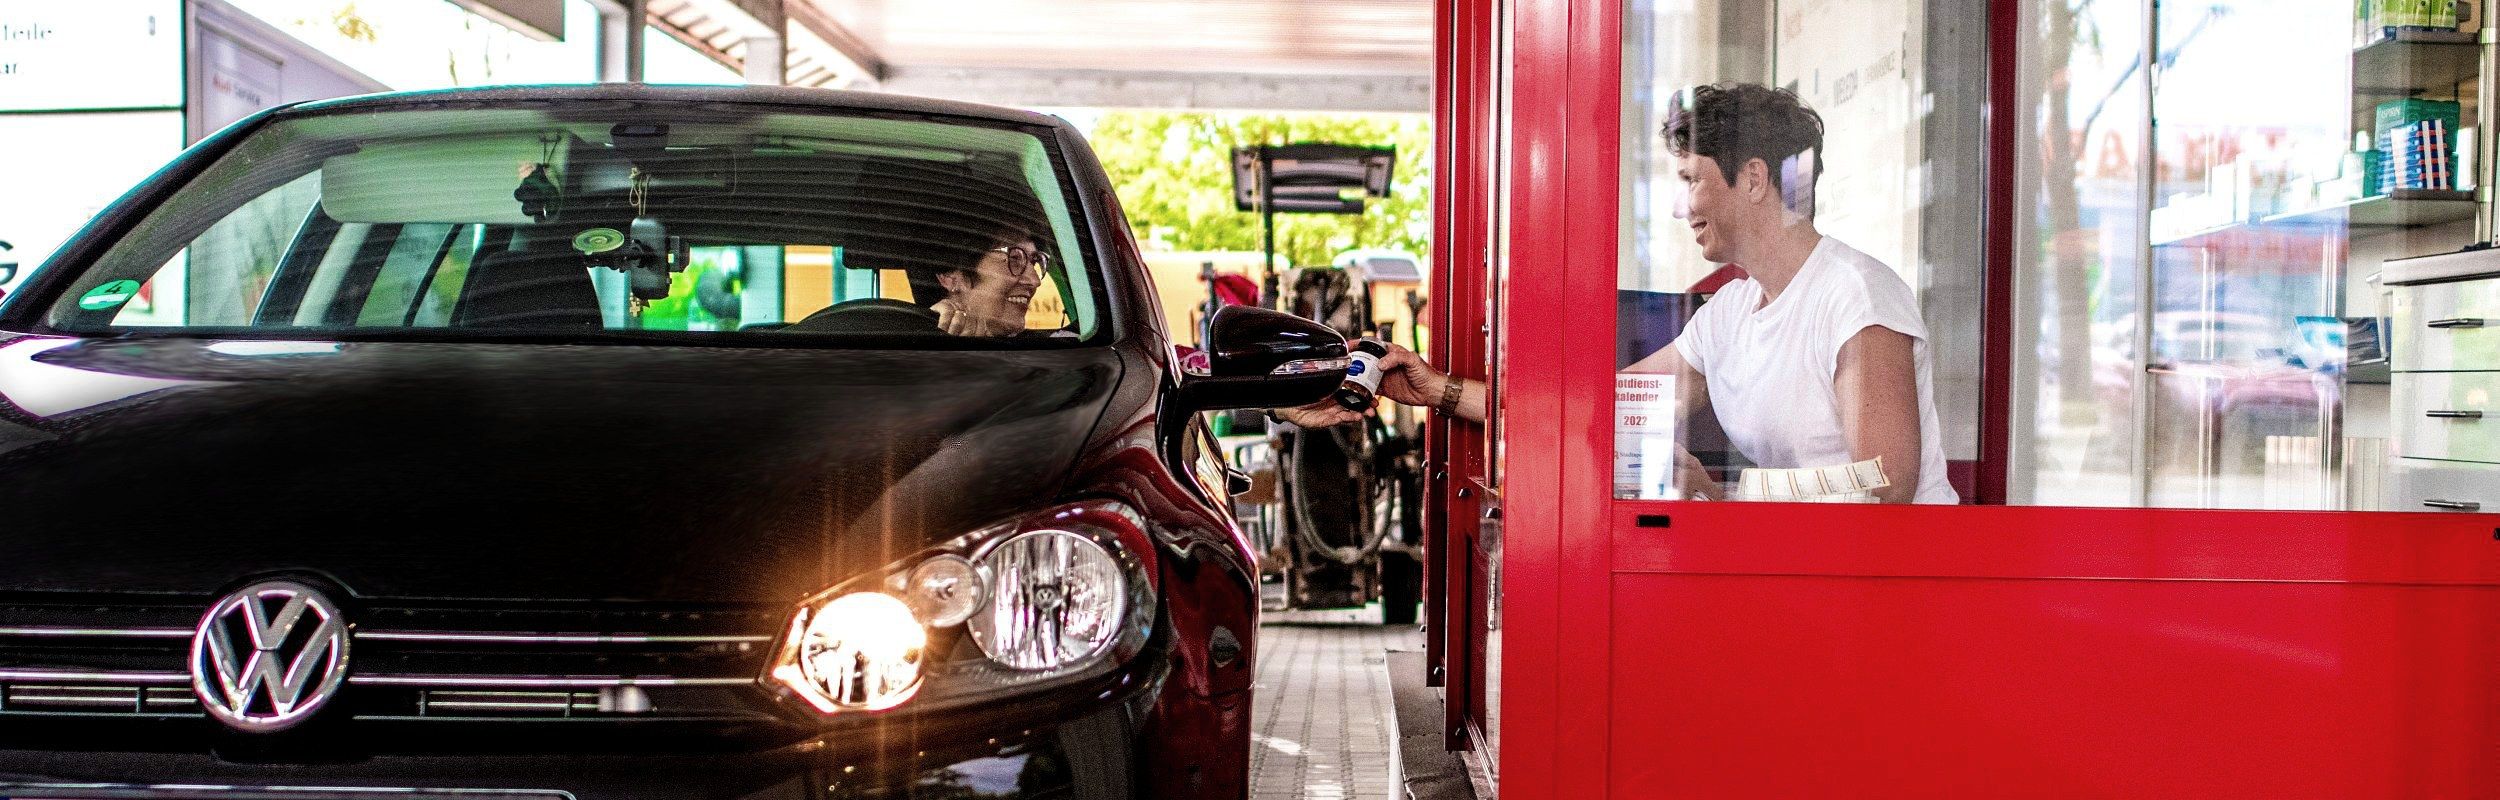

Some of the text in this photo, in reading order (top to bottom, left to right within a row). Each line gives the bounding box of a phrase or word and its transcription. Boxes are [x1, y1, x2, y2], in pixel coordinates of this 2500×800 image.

[104, 280, 126, 295] 4
[1615, 377, 1663, 389] otdienst-
[1623, 415, 1648, 426] 2022
